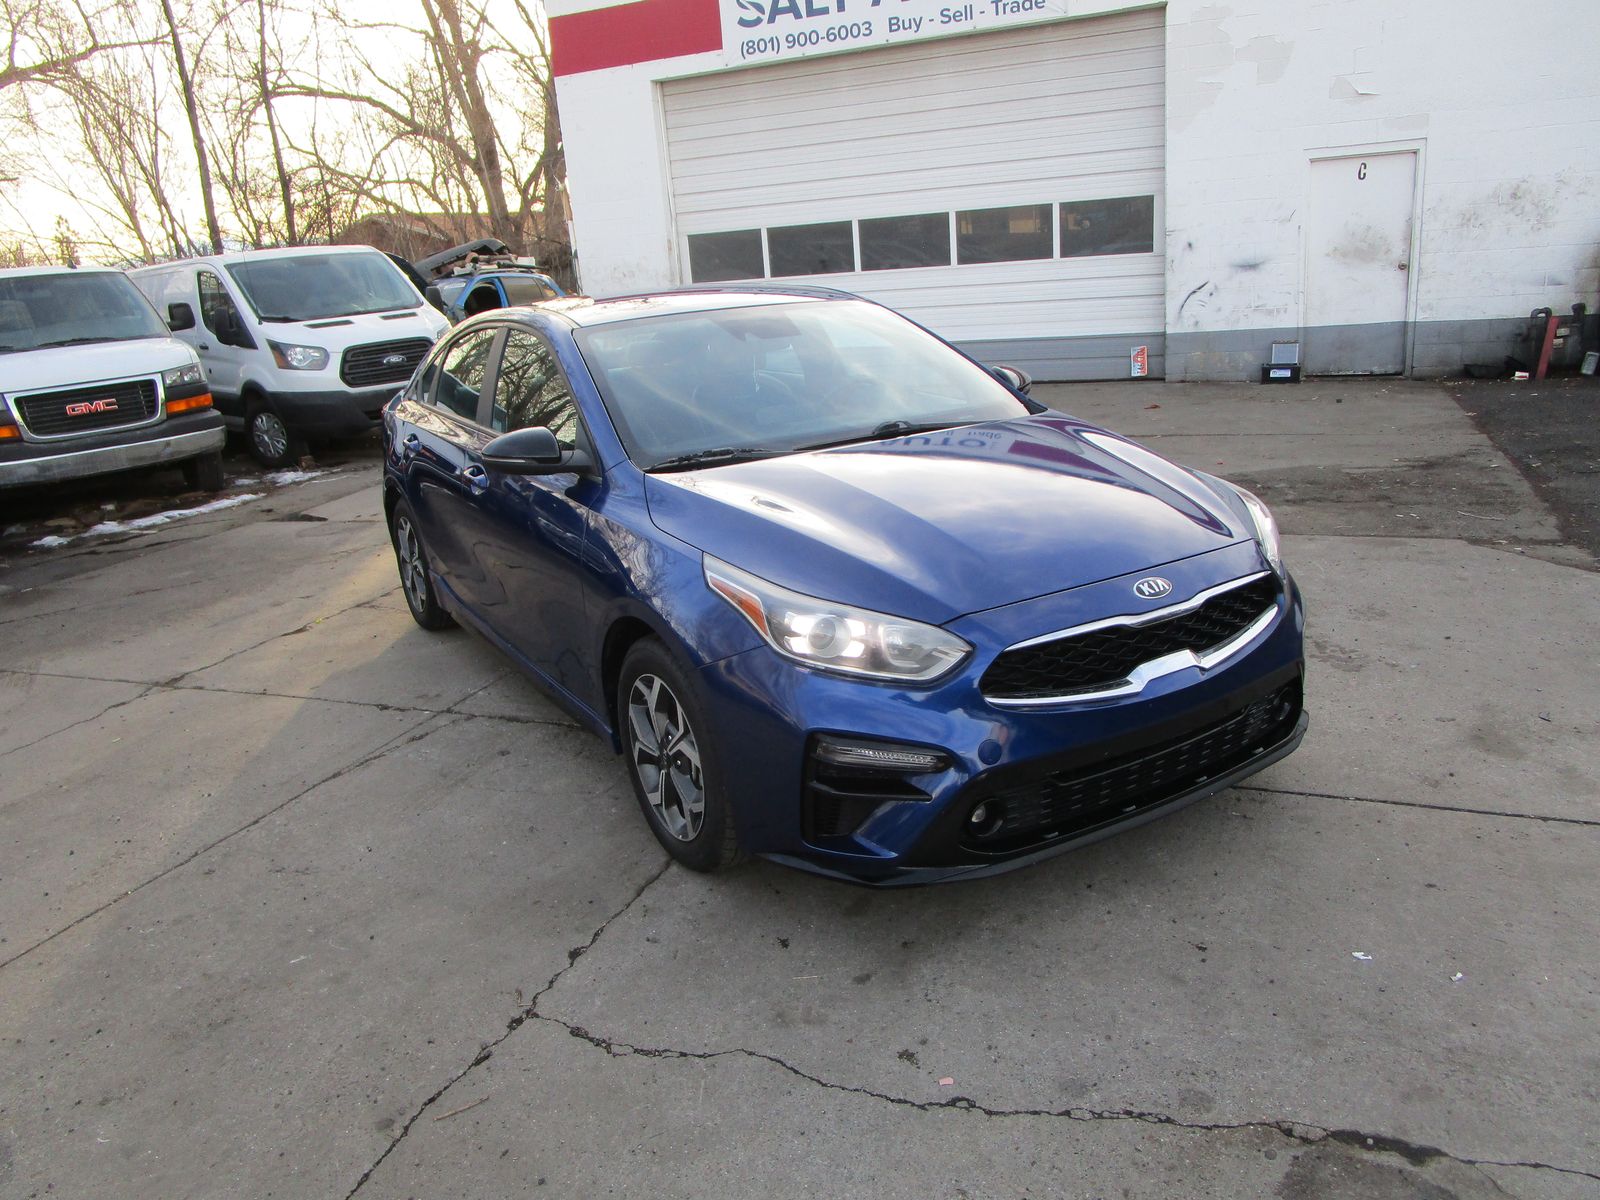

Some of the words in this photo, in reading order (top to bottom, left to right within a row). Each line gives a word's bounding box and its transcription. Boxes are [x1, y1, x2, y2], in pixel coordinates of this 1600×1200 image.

[741, 36, 780, 59] (801)
[785, 21, 873, 49] 900-6003
[888, 16, 923, 33] Buy
[940, 4, 974, 25] Sell
[991, 0, 1046, 16] Trade
[1357, 162, 1367, 181] C
[66, 398, 119, 416] GMC
[1137, 579, 1170, 596] KIA
